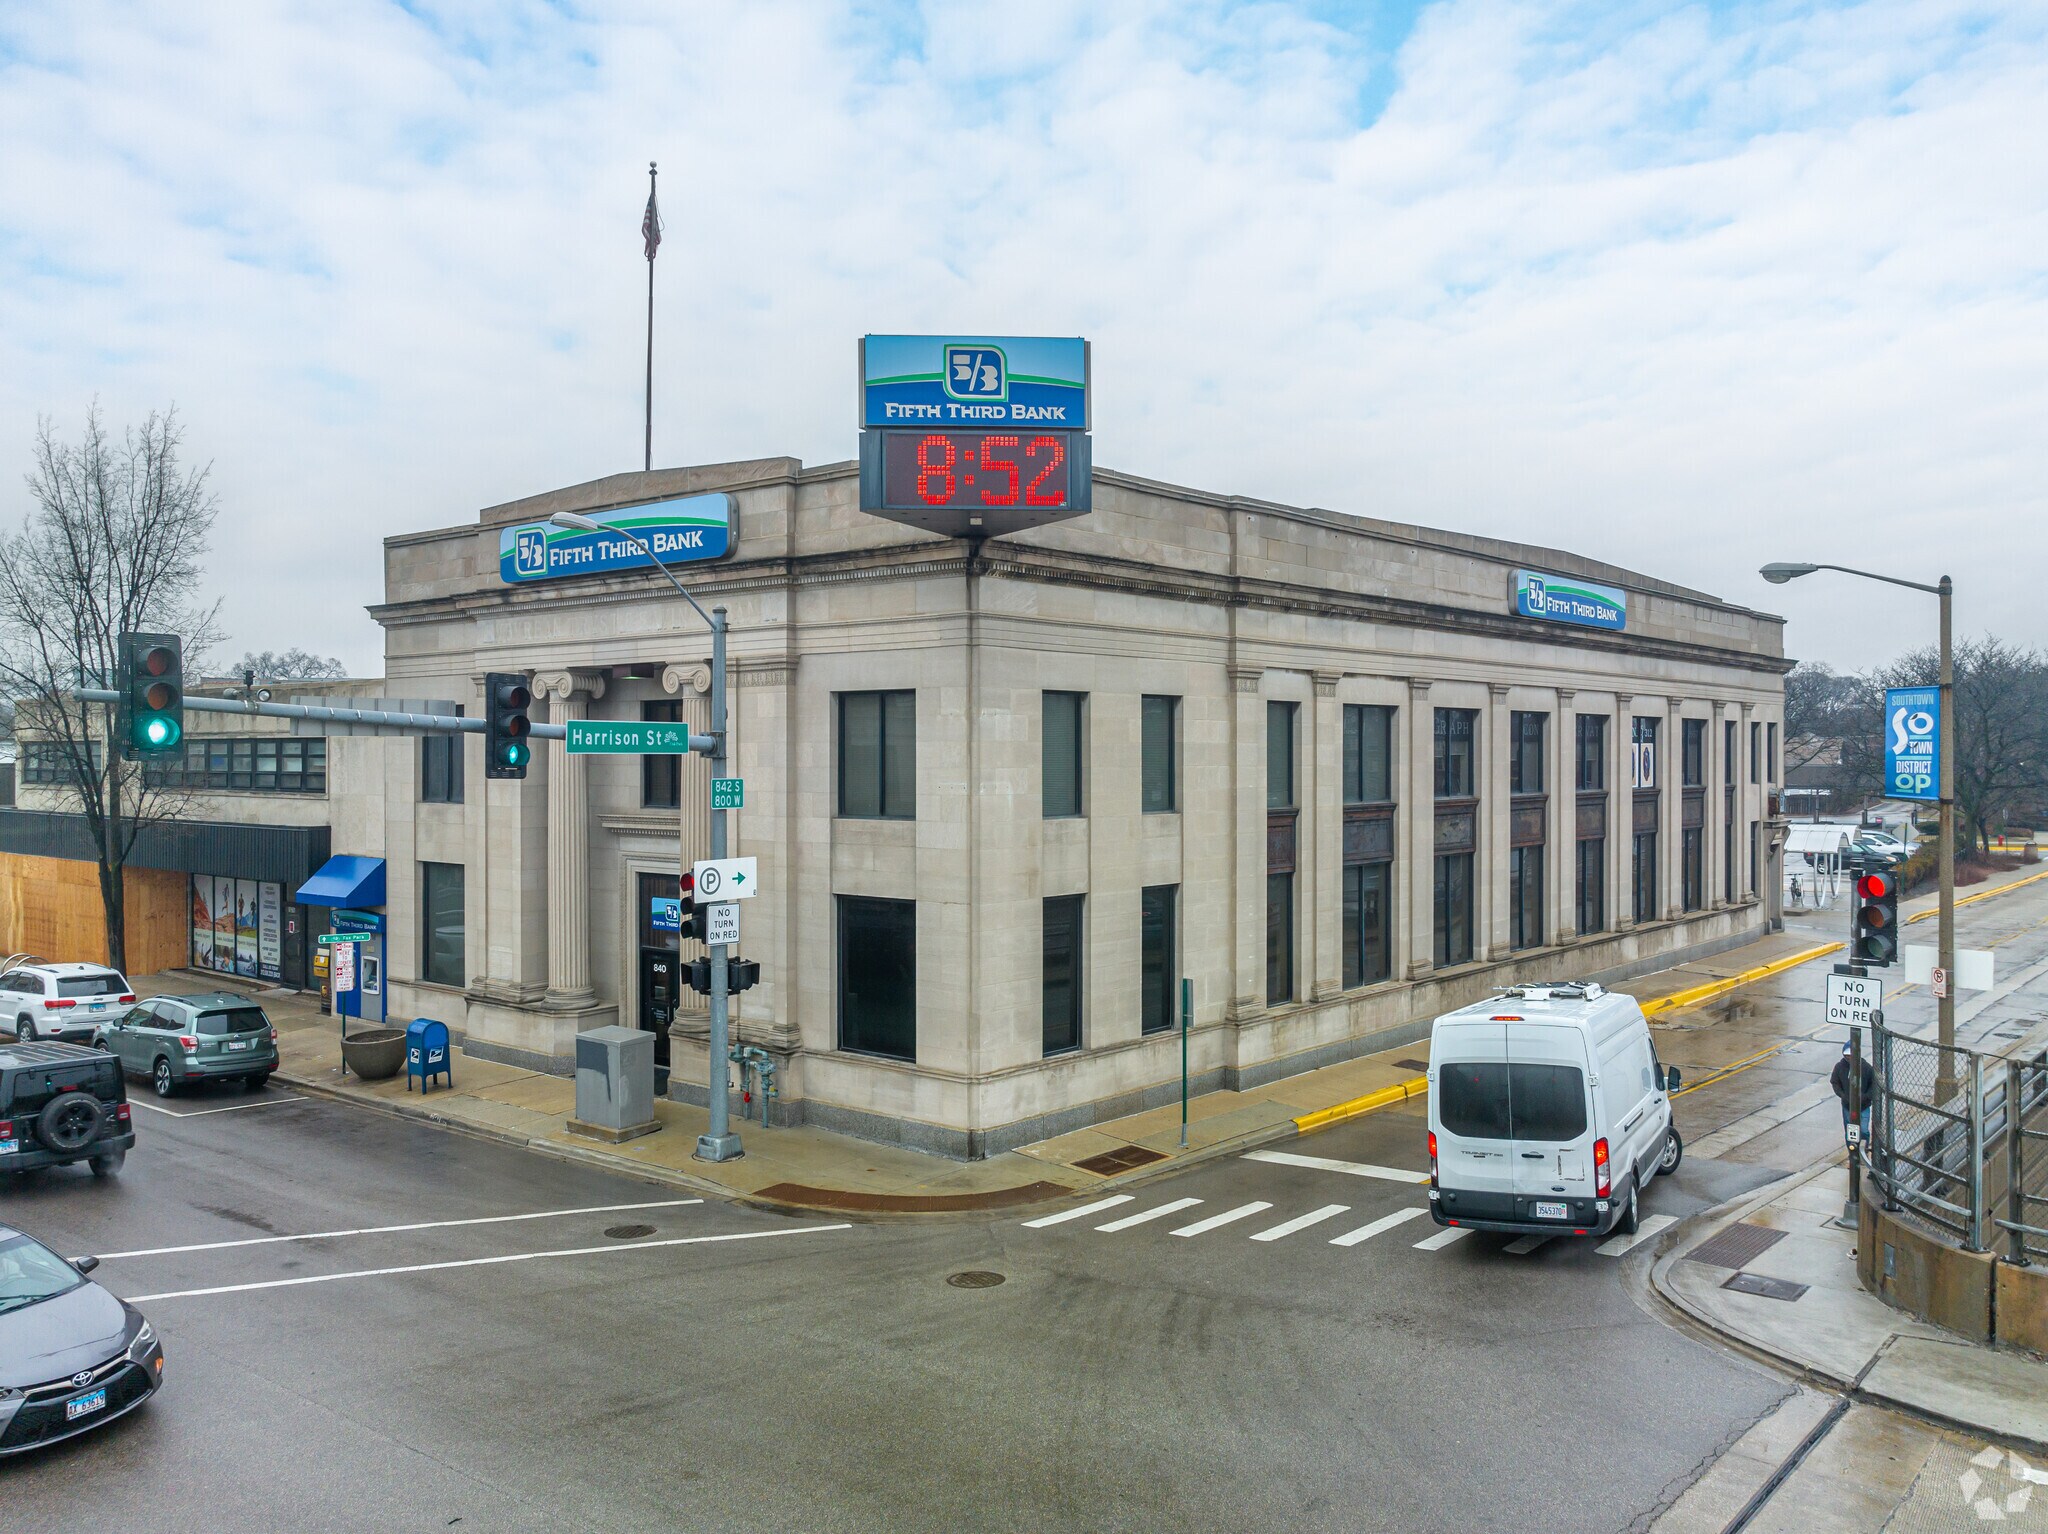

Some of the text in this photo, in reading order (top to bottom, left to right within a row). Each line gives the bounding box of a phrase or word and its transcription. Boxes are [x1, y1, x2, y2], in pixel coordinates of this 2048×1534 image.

[885, 402, 1066, 420] FIFTH THIRD BANK
[917, 435, 1064, 506] 8:52
[550, 530, 704, 567] FIFTH THIRD BANK
[1546, 596, 1618, 621] FIFTH THIRD BANK
[1891, 694, 1934, 706] SOUTHTOWN
[572, 729, 662, 746] Harrison St
[1908, 741, 1933, 755] TOWN
[1895, 760, 1932, 774] DISTRICT
[715, 781, 740, 792] 842 S
[1895, 773, 1932, 794] OP
[714, 795, 740, 806] 800 W
[706, 873, 717, 890] P
[717, 908, 731, 917] NO
[714, 919, 734, 929] TURN
[709, 930, 738, 940] ON RED
[653, 963, 667, 973] 840
[1844, 982, 1865, 993] NO
[1838, 995, 1870, 1008] TURN
[1830, 1008, 1872, 1022] ON RE
